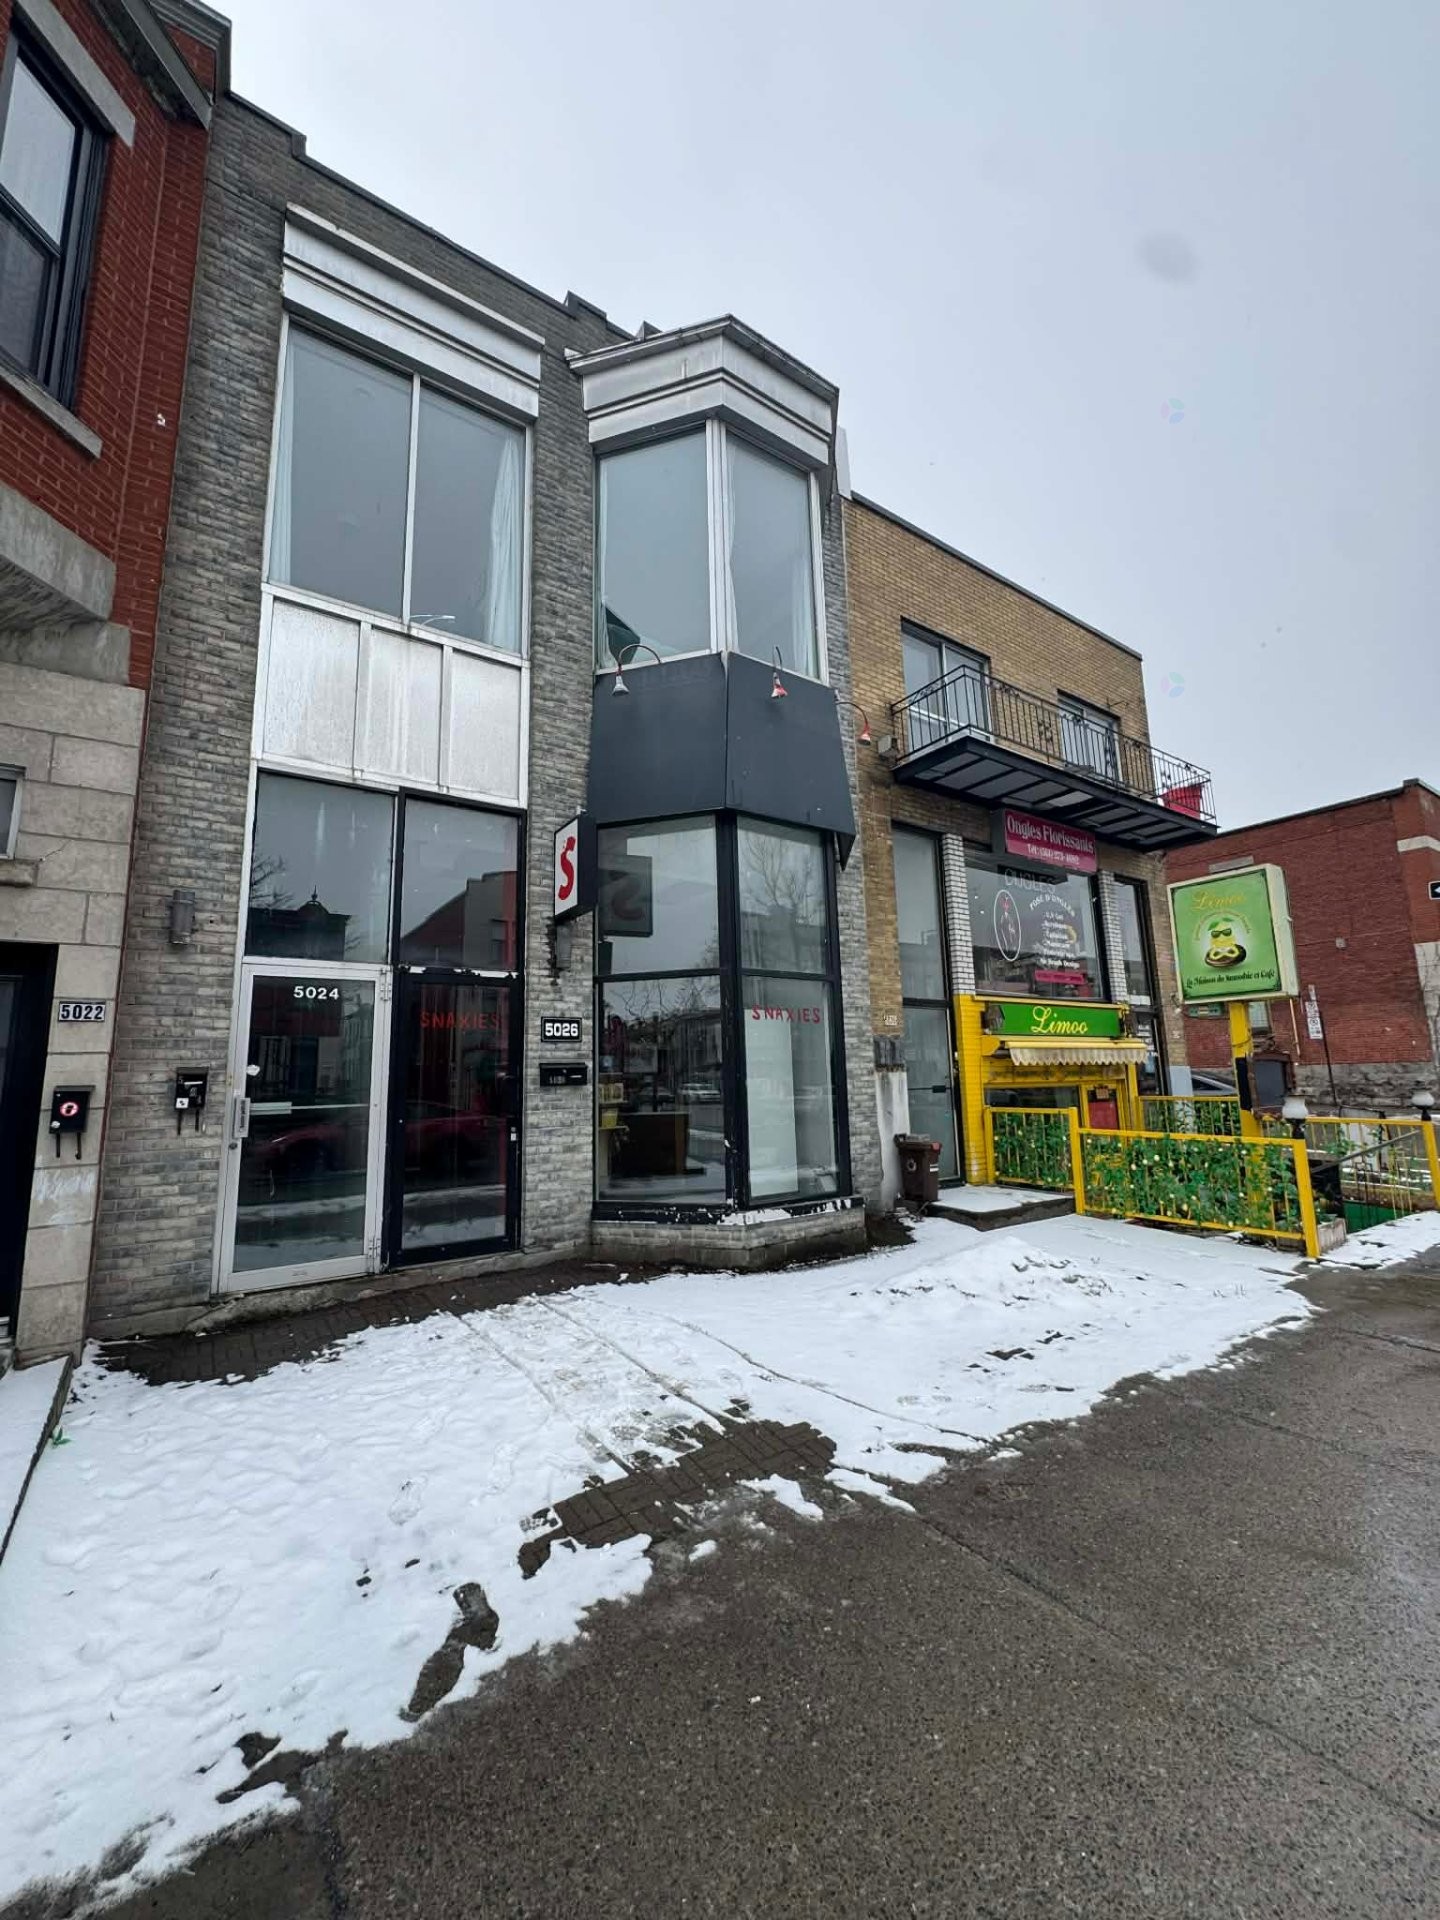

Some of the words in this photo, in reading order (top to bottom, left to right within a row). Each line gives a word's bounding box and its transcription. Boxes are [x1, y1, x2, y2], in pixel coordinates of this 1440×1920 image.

[1006, 814, 1041, 840] Ongles
[1042, 825, 1094, 853] Florissants
[558, 836, 576, 900] S
[293, 985, 340, 1000] 5024
[61, 1005, 104, 1020] 5022
[420, 1010, 500, 1029] SNAXIES
[752, 1004, 821, 1024] SNAXIES
[1031, 1005, 1089, 1034] Limoo
[545, 1022, 579, 1037] 5026
